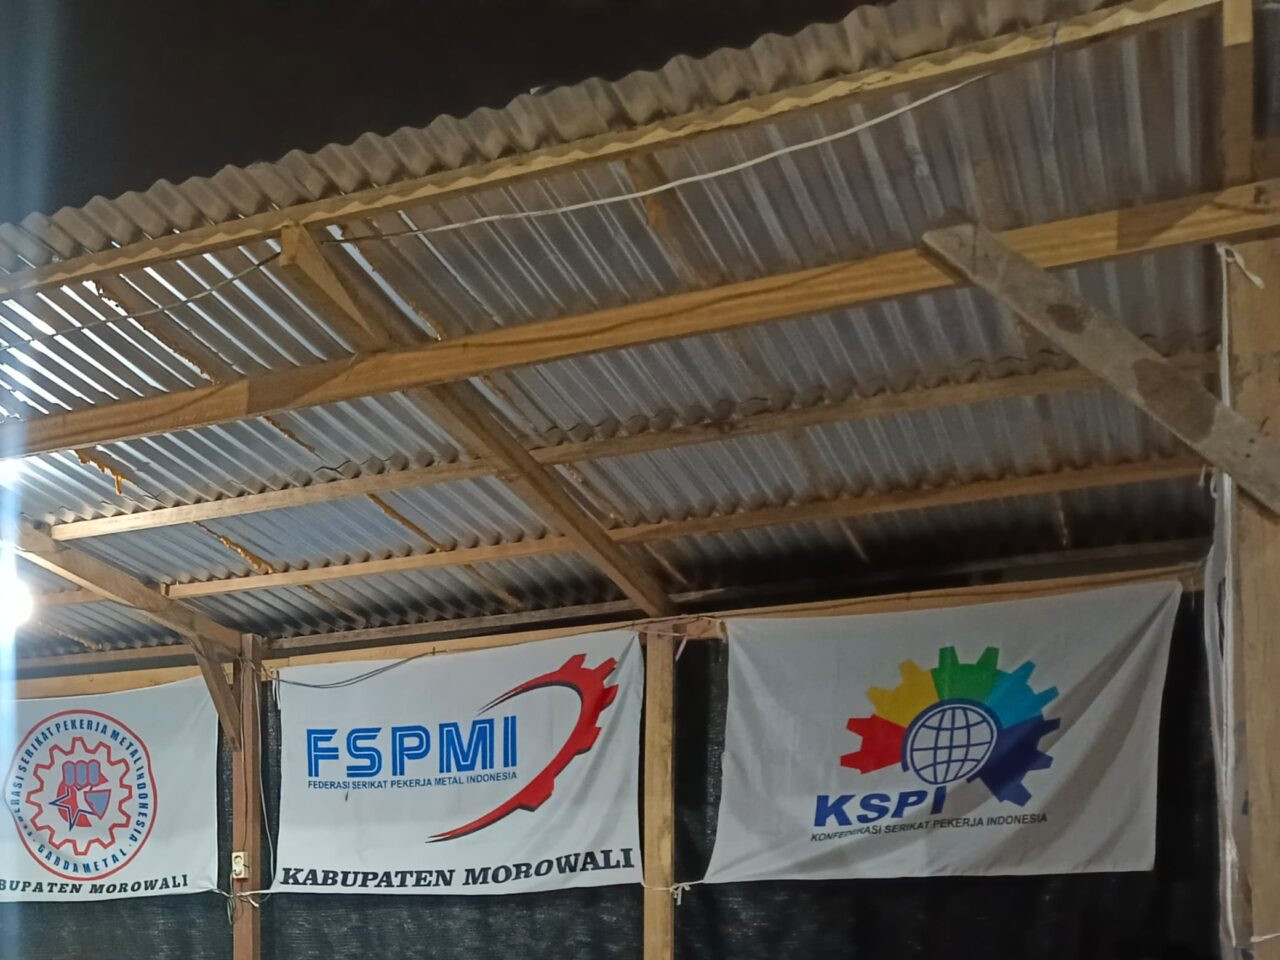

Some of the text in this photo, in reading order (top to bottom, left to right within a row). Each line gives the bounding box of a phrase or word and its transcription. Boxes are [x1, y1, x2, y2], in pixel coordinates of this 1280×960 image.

[18, 727, 55, 773] SERIKAT
[55, 719, 108, 735] PEKERJA
[306, 715, 518, 778] FSPMI
[308, 771, 518, 790] FEDERASI SERIKAT PEKERJA METAL INDONESIA
[814, 786, 947, 827] KSPI
[884, 820, 931, 835] SERIKAT
[932, 816, 985, 830] PEKERJA
[986, 812, 1048, 827] INDONESIA
[89, 874, 189, 895] MOROWALI
[279, 848, 635, 888] KABUPATEN MOROWALI
